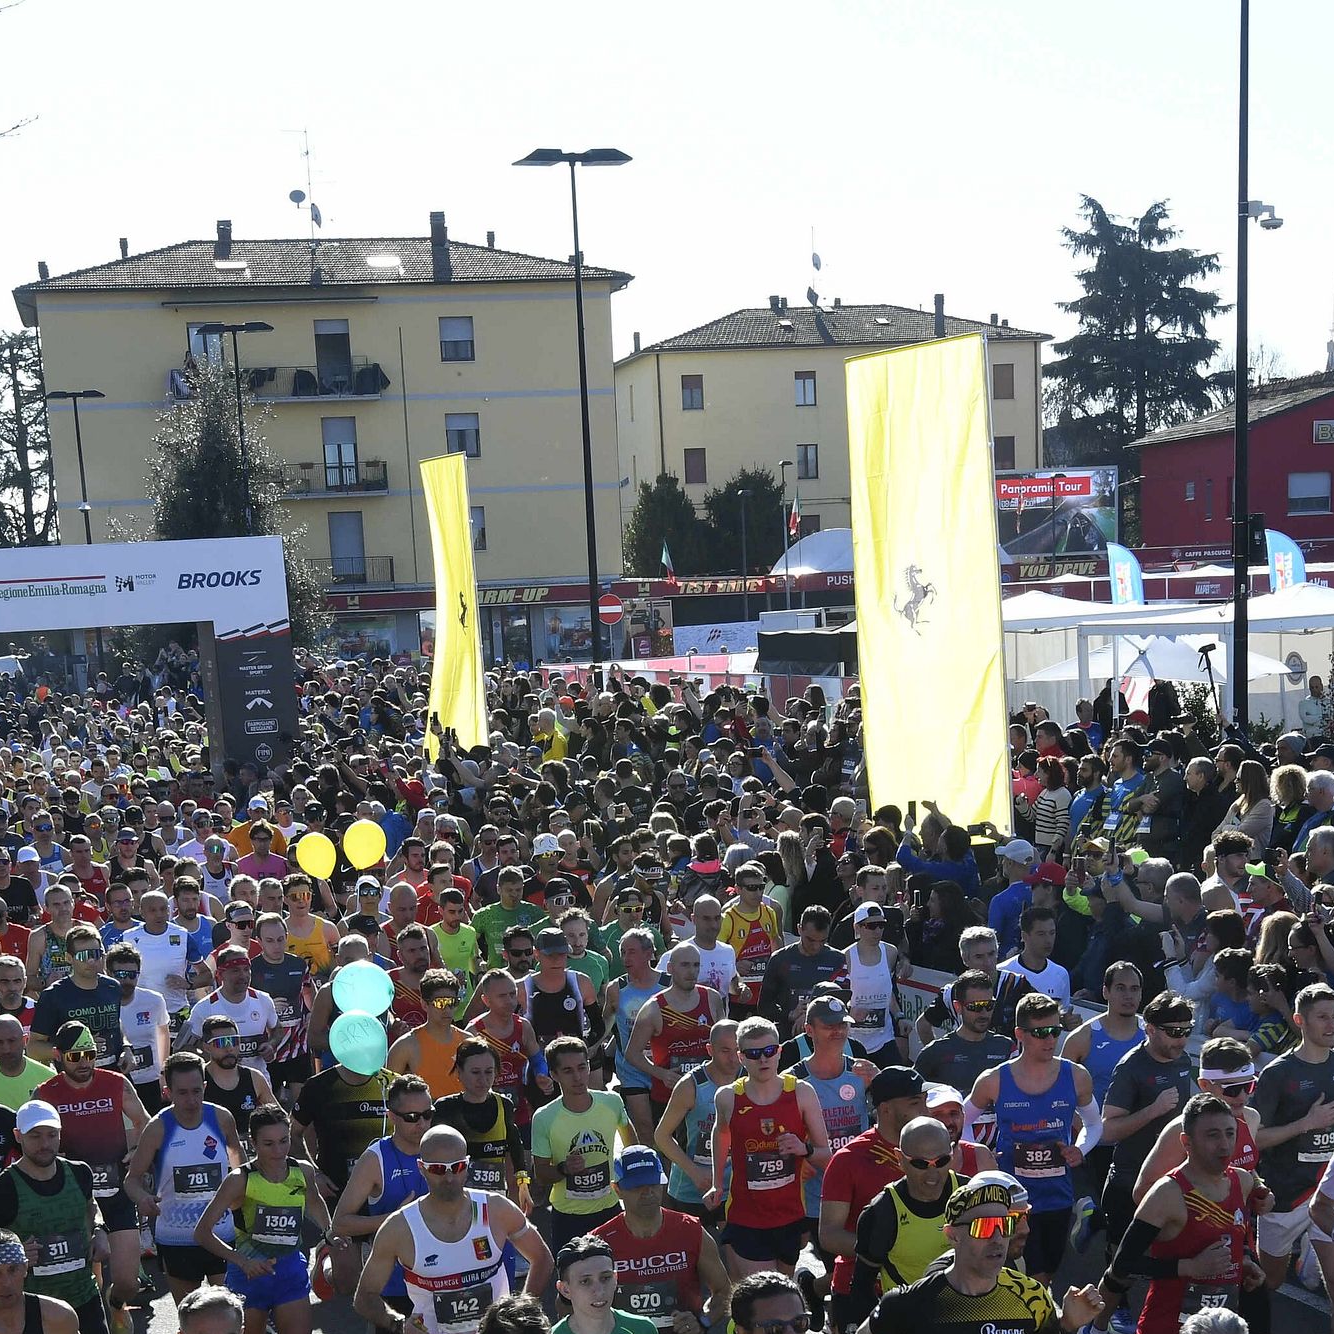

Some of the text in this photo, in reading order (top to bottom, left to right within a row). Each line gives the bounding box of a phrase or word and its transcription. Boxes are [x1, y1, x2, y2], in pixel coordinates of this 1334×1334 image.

[1000, 481, 1082, 495] Panoramic Tour
[1019, 564, 1050, 578] YOU
[177, 570, 263, 590] BROOKS
[678, 580, 711, 595] TEST
[67, 1003, 117, 1018] COMO LAKE
[56, 1098, 114, 1115] BUCCI
[74, 1106, 115, 1117] INDUSTRIES
[1025, 1150, 1052, 1163] 382
[759, 1159, 785, 1172] 759
[187, 1173, 209, 1185] 781
[472, 1169, 501, 1183] 3366
[573, 1171, 605, 1187] 6305
[265, 1215, 297, 1229] 1304
[48, 1242, 69, 1255] 311
[614, 1250, 688, 1274] BUCCI
[637, 1262, 689, 1277] INDUSTRIES
[450, 1297, 480, 1314] 142
[630, 1292, 661, 1309] 670
[1200, 1293, 1229, 1308] 537
